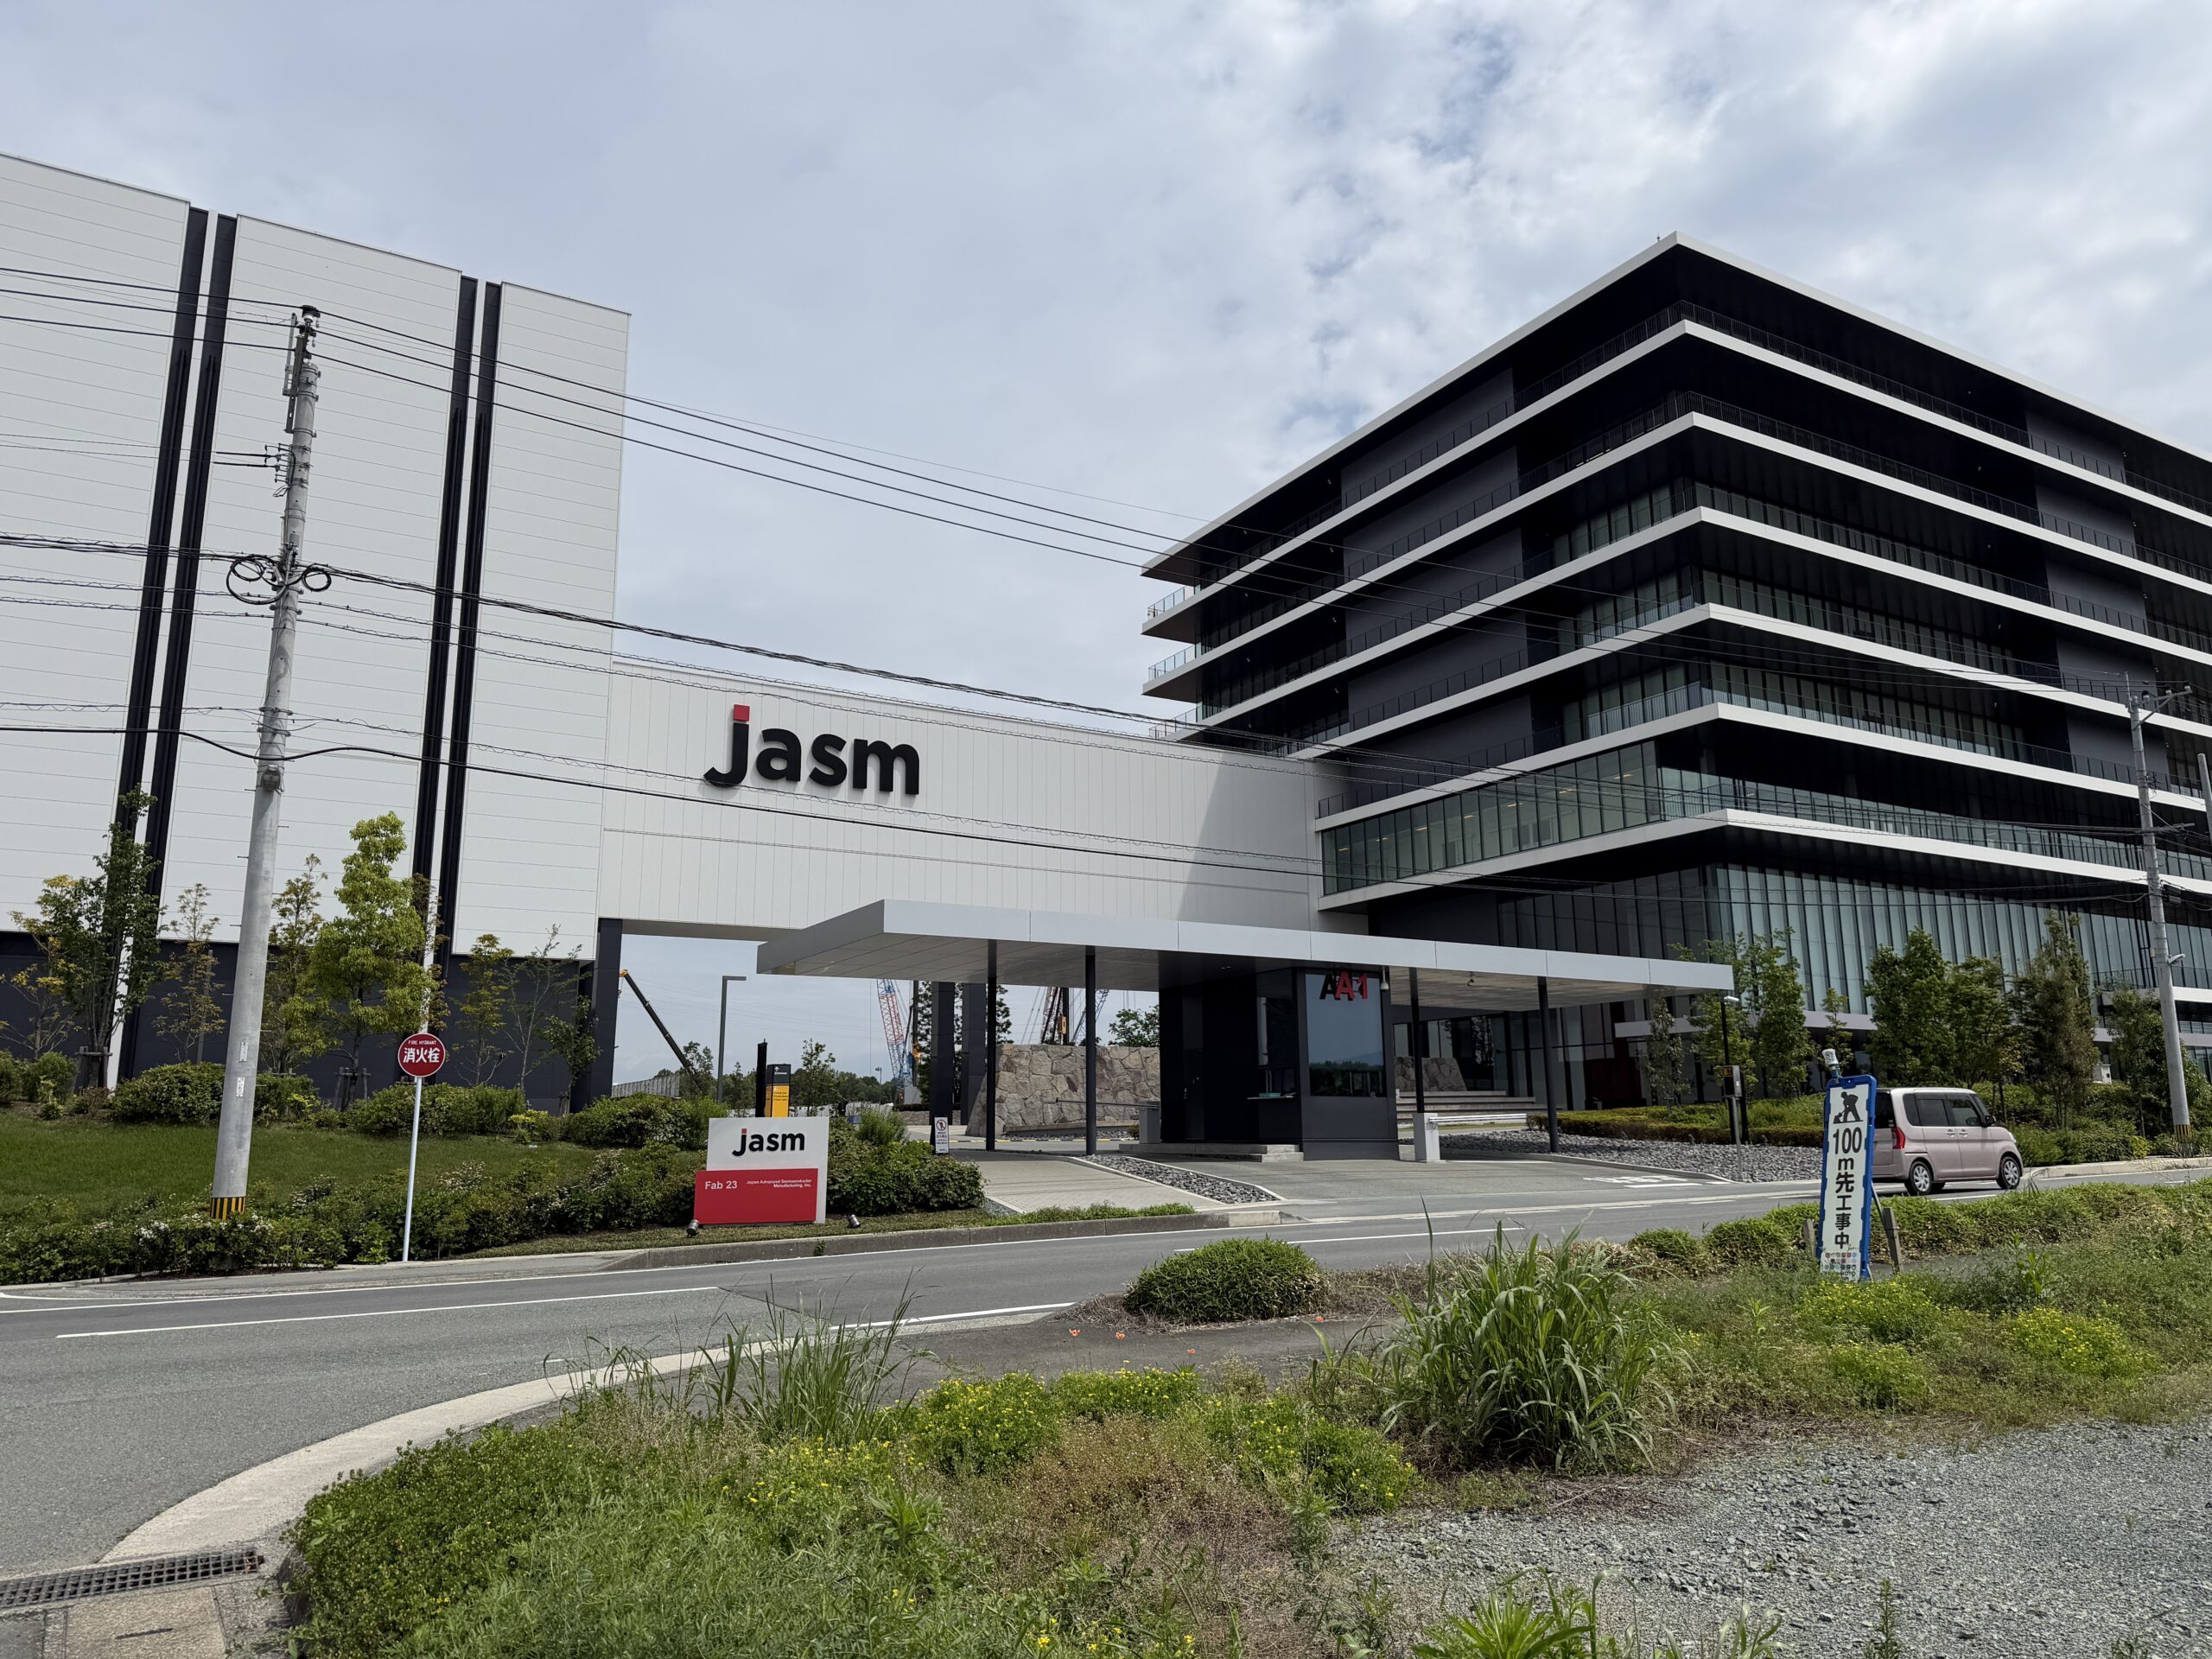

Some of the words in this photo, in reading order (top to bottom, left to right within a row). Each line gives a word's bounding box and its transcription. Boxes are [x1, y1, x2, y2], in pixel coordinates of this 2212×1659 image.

[703, 704, 919, 795] jasm
[404, 1047, 441, 1064] 消火栓
[732, 1128, 805, 1157] jasm
[704, 1180, 723, 1190] Fab
[726, 1180, 738, 1189] 23
